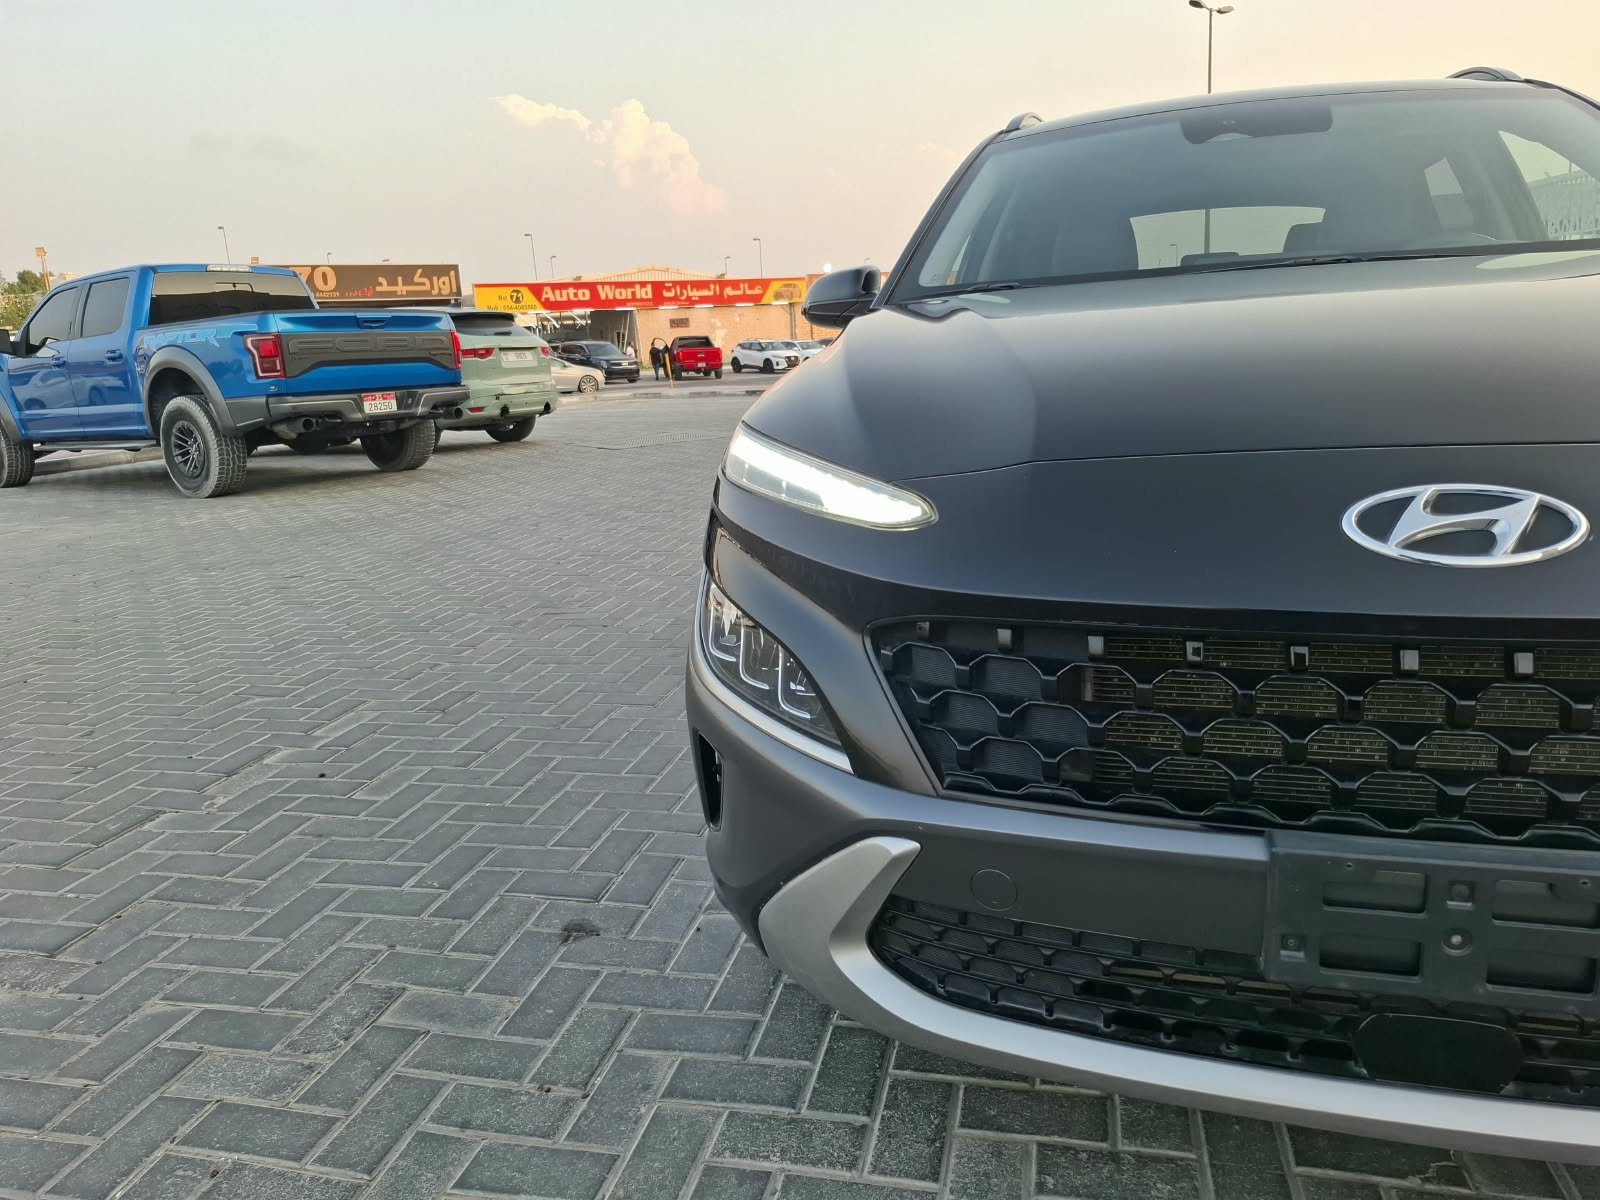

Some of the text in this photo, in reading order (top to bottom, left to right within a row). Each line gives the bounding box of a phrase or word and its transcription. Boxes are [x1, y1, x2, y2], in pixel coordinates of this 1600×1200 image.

[511, 292, 522, 302] 71
[541, 284, 652, 302] Auto World
[662, 283, 764, 300] عالم السيارات
[368, 401, 393, 411] 28250
